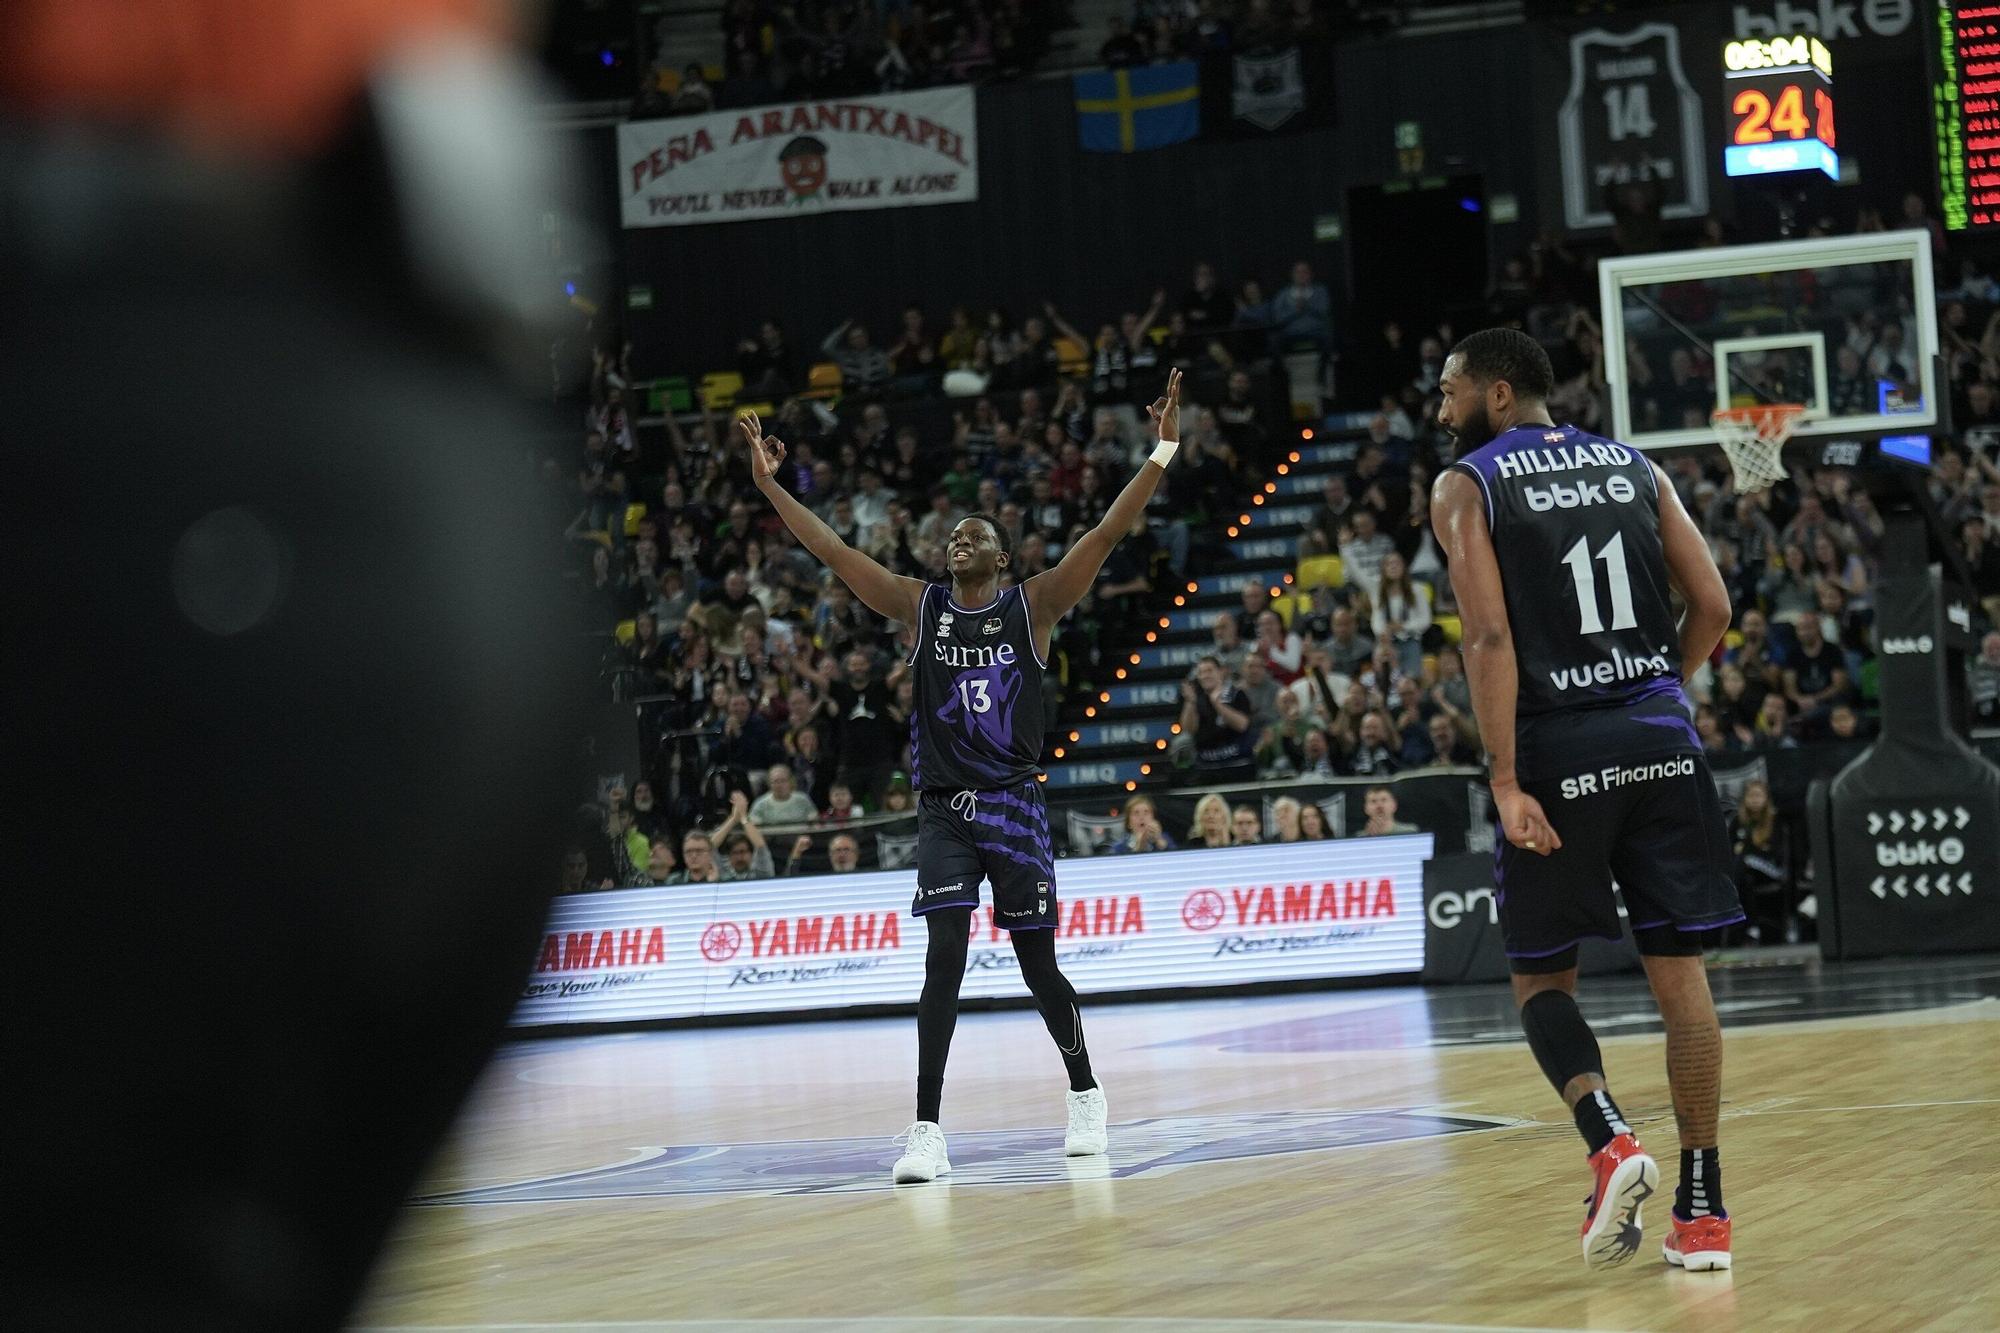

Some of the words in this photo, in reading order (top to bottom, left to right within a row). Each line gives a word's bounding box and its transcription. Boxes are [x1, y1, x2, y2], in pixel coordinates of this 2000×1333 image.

[1603, 83, 1657, 140] 14
[1733, 85, 1810, 145] 24
[632, 128, 714, 194] PEÑA
[731, 104, 969, 167] ARANTXAPEL
[721, 188, 788, 211] NEVER
[828, 177, 882, 199] WALK
[890, 173, 958, 195] ALONE
[1494, 444, 1632, 479] HILLIARD
[1524, 480, 1606, 512] bbk
[1561, 530, 1638, 635] 11
[934, 640, 1016, 668] surne
[958, 679, 992, 713] 13
[1131, 686, 1177, 705] IMQ
[1101, 723, 1147, 744] IMQ
[1069, 763, 1117, 784] IMQ
[1560, 773, 1598, 799] SR
[935, 885, 962, 895] CORREO
[1233, 879, 1396, 926] YAMAHA
[748, 912, 902, 958] YAMAHA
[985, 896, 1145, 942] YAHA
[537, 926, 666, 972] AMAHA
[524, 983, 558, 995] evs
